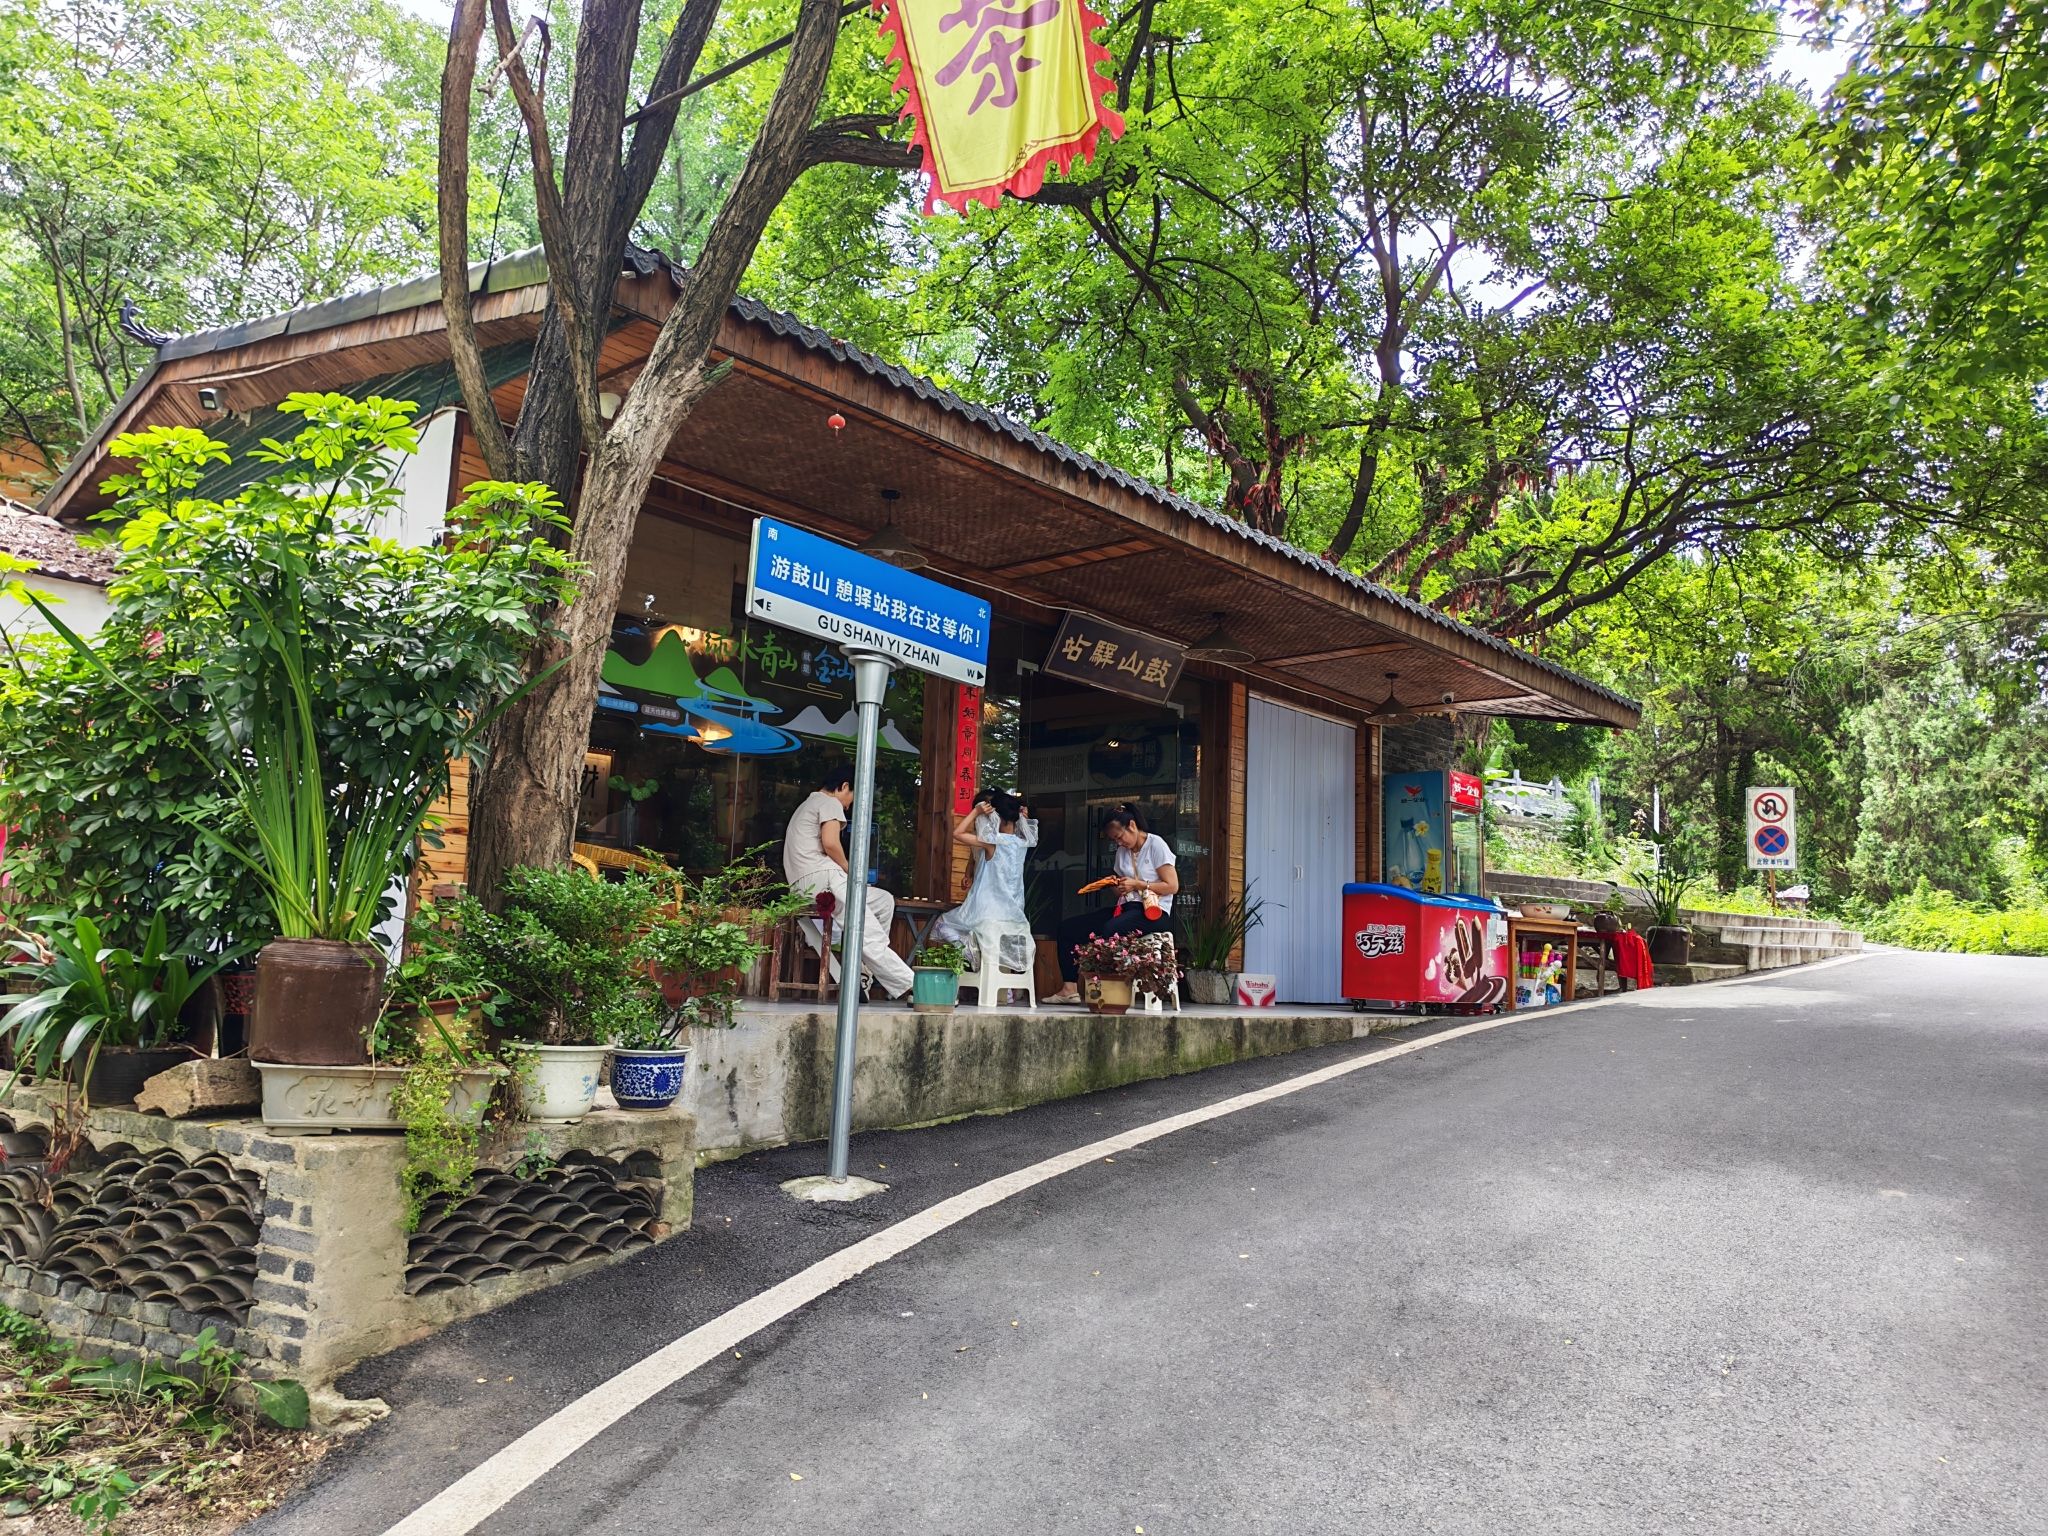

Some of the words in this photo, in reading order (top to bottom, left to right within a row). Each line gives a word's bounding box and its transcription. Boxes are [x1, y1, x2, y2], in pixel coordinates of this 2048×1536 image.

[935, 0, 1060, 115] 茶
[767, 527, 778, 541] 南
[770, 554, 830, 595] 游鼓山
[766, 601, 772, 612] E
[978, 607, 987, 619] 北
[818, 615, 839, 633] GU
[843, 622, 884, 648] SHAN
[887, 637, 901, 654] YI
[903, 643, 940, 667] ZHAN
[966, 668, 976, 678] W
[1356, 931, 1405, 958] 巧乐兹
